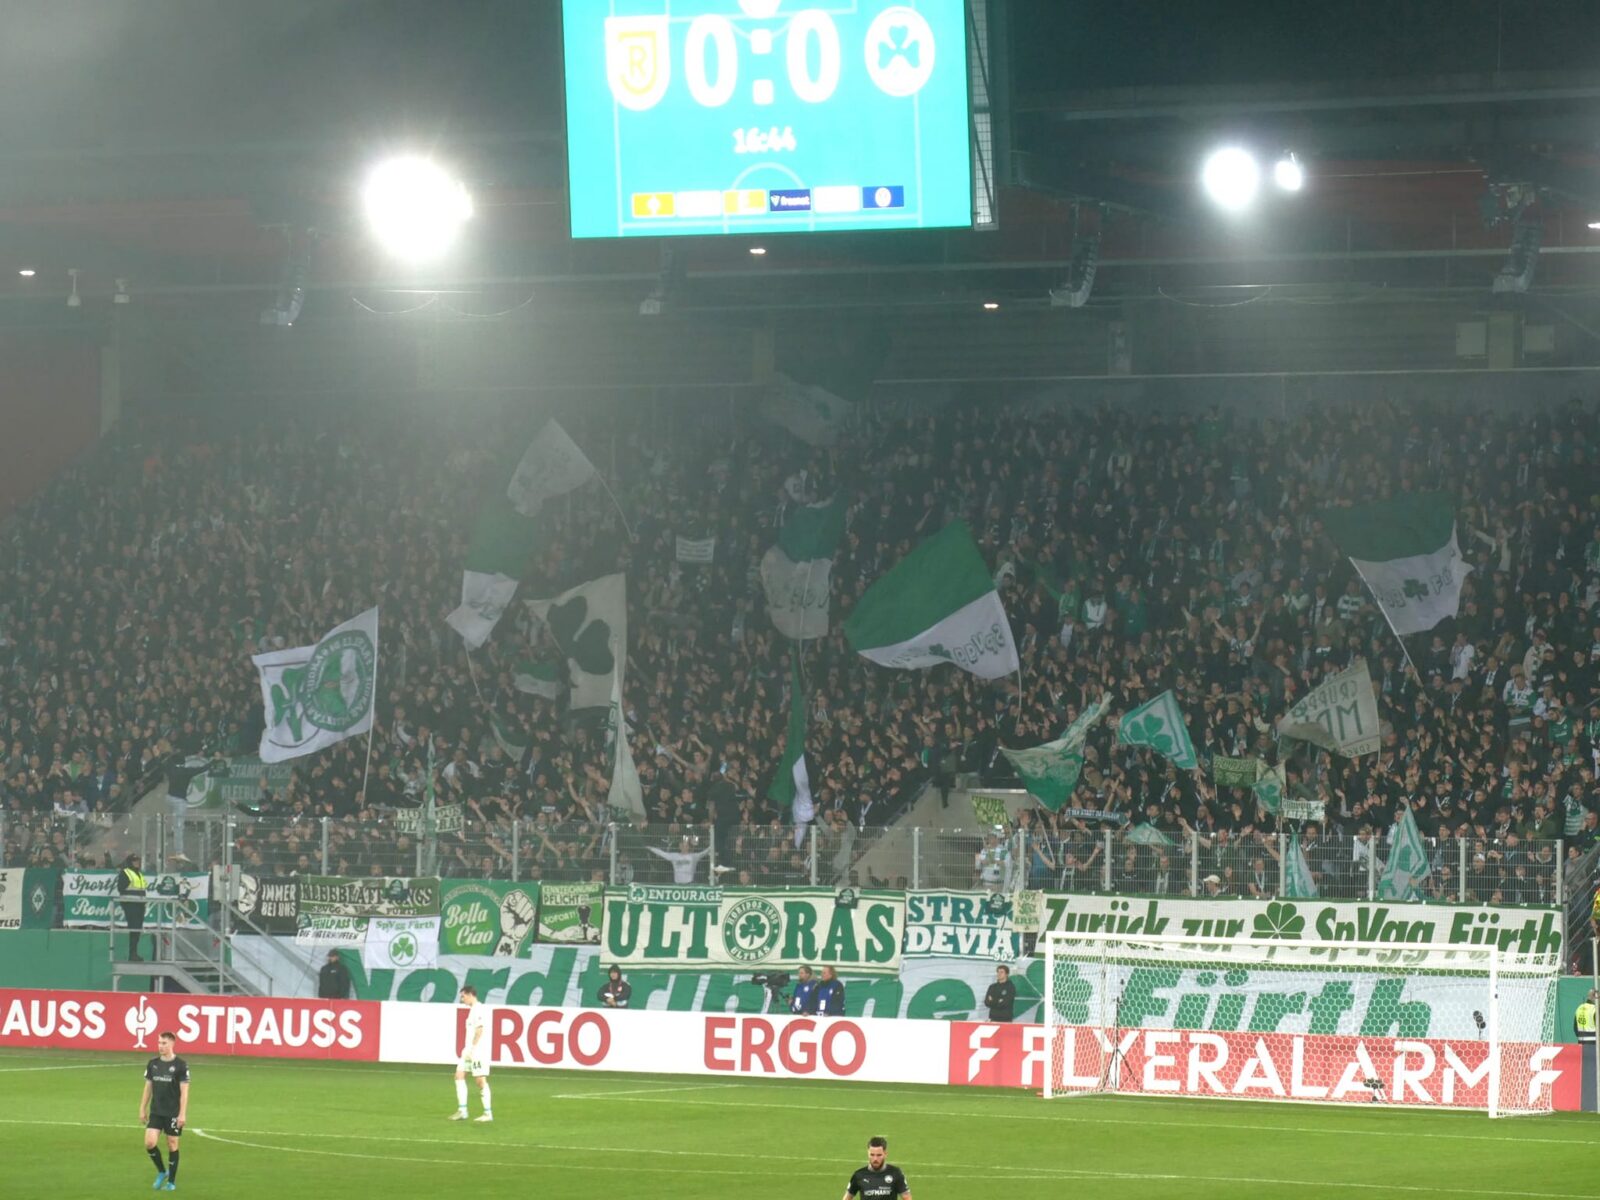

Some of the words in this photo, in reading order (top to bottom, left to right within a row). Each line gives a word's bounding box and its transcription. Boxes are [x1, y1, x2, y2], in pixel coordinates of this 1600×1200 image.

[732, 126, 797, 154] 16:44
[262, 884, 296, 901] IMMER
[543, 894, 580, 905] PFLICHT
[648, 888, 722, 902] ENTOURAGE
[261, 902, 277, 917] BEI
[445, 902, 489, 928] Bella
[726, 901, 762, 925] HORIDOS
[313, 918, 351, 929] FEHLPASS
[376, 921, 405, 933] SpVgg
[408, 920, 435, 930] Fürth
[1039, 898, 1170, 951] Zurück
[1179, 918, 1245, 952] zur
[1310, 906, 1436, 963] SpVgg
[1445, 912, 1563, 965] Fürth
[456, 926, 494, 947] Ciao
[906, 926, 1014, 956] DEVIA
[730, 946, 770, 960] ULTRAS
[0, 999, 107, 1040] AUSS
[177, 1004, 363, 1049] STRAUSS
[703, 1016, 867, 1077] ERGO
[1021, 1026, 1495, 1105] FLYERALARM
